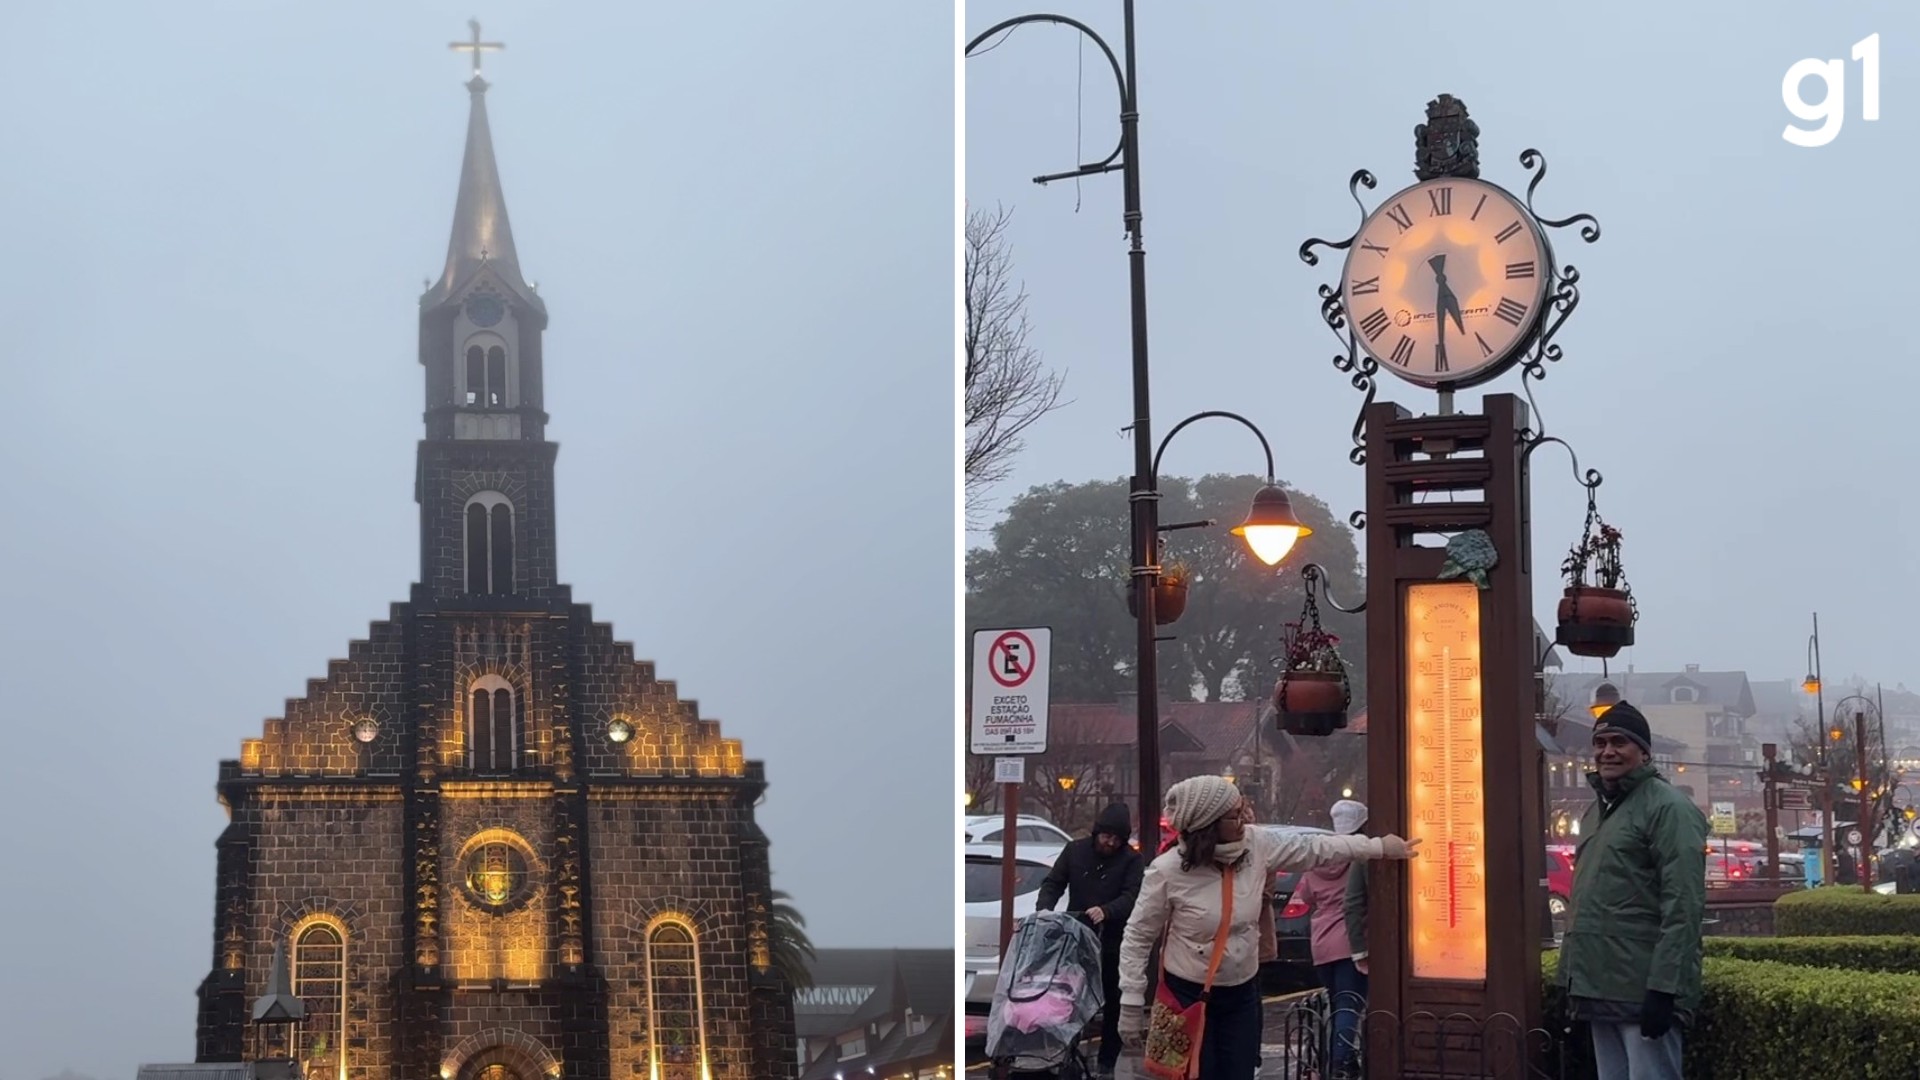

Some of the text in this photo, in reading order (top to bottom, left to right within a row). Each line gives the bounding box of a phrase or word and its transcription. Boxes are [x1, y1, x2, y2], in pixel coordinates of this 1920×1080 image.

[1428, 187, 1453, 217] XII
[1386, 203, 1413, 235] XI
[1494, 220, 1523, 244] II
[1361, 239, 1389, 259] X
[1505, 261, 1534, 280] III
[1352, 276, 1379, 296] IX
[1494, 297, 1528, 327] IIII
[1359, 307, 1391, 343] VIII
[1474, 331, 1494, 358] V
[1390, 334, 1416, 368] VII
[1418, 661, 1432, 673] 50
[1460, 666, 1478, 678] 120
[993, 695, 1028, 705] EXCETO
[1418, 698, 1432, 710] 40
[990, 704, 1030, 715] ESTAÇÃO
[1460, 707, 1478, 719] 100
[985, 715, 1034, 724] FUMACINHA
[985, 728, 999, 736] DAS
[1419, 735, 1433, 746] 30
[1464, 748, 1477, 760] 80
[1420, 772, 1434, 783] 20
[1464, 790, 1478, 801] 60
[1466, 831, 1480, 843] 40
[1424, 848, 1432, 860] 0
[1466, 873, 1480, 884] 20
